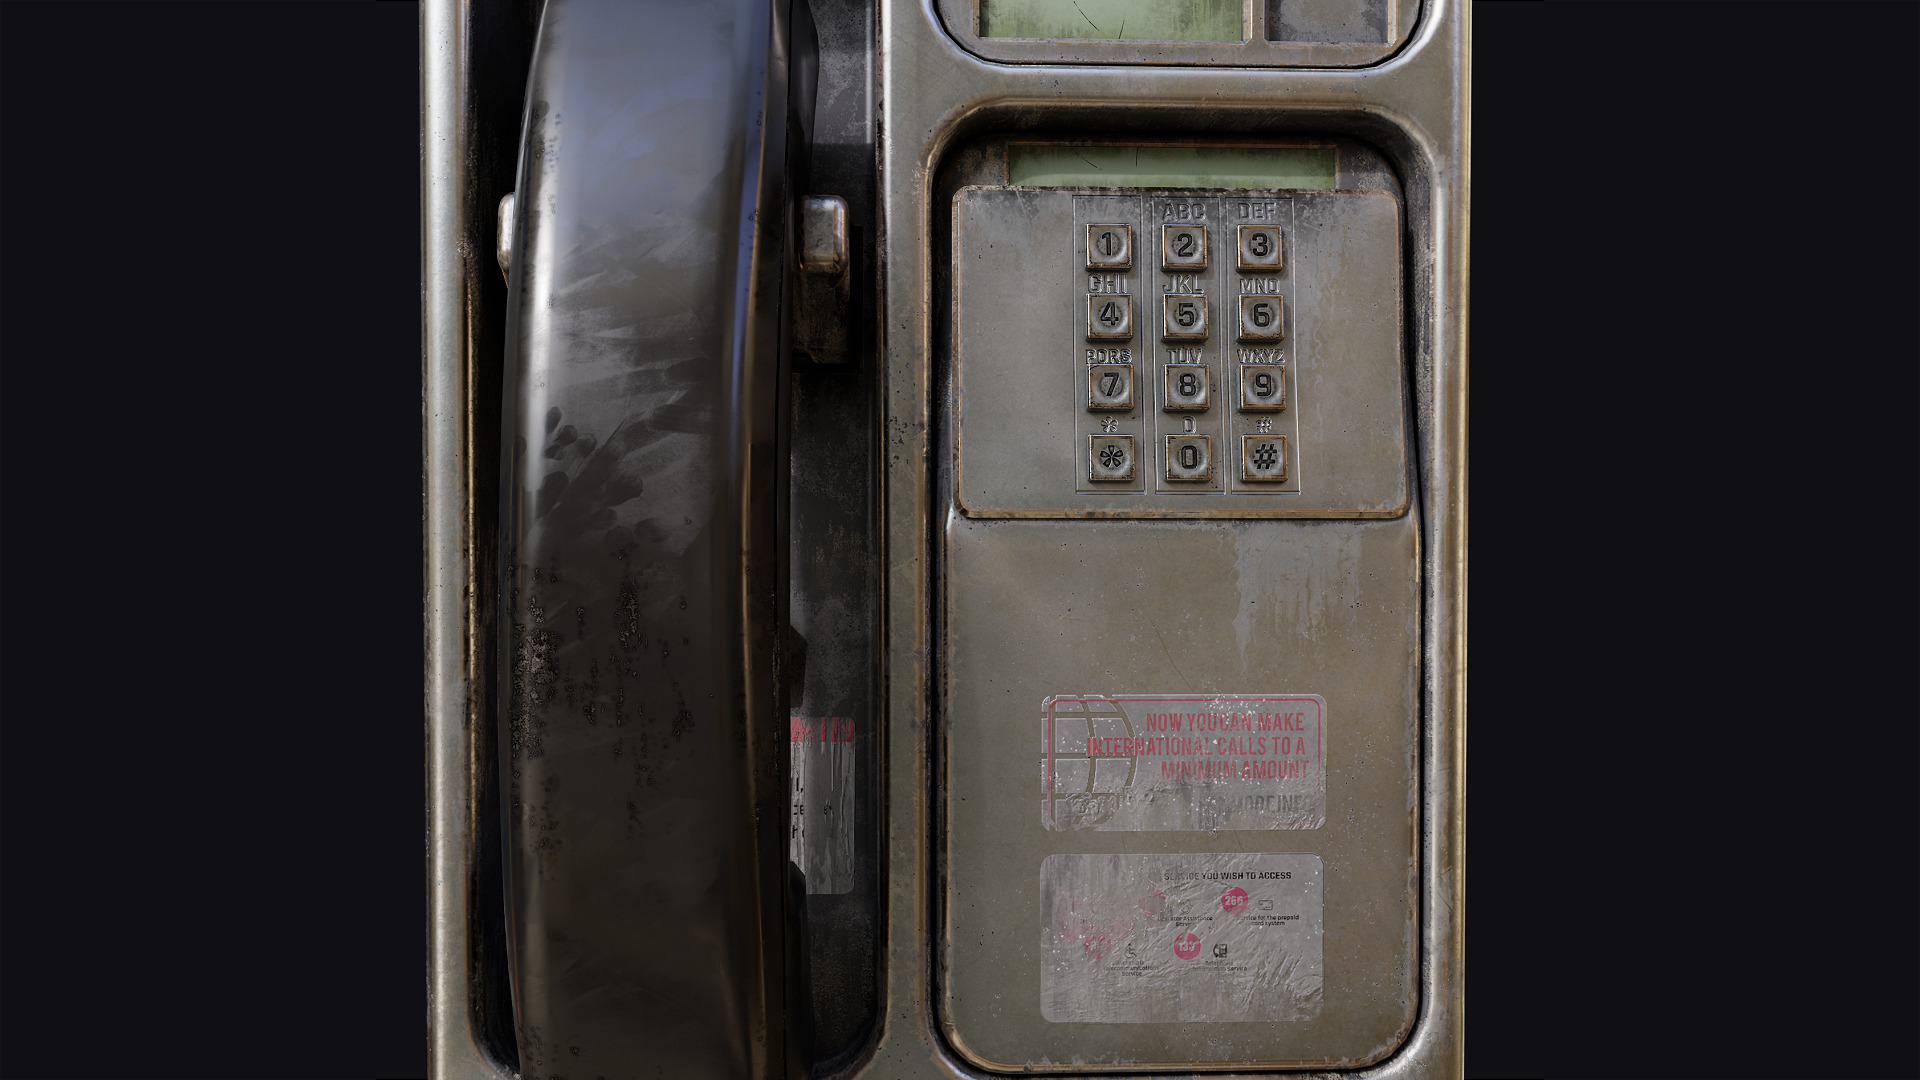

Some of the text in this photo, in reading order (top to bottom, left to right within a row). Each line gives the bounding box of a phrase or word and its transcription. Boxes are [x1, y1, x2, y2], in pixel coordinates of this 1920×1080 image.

[1163, 203, 1206, 221] ABC
[1238, 202, 1277, 221] DEF
[1101, 232, 1111, 256] 1
[1177, 233, 1194, 257] 2
[1252, 233, 1269, 257] 3
[1087, 274, 1128, 293] GHI
[1162, 275, 1204, 293] JKL
[1100, 302, 1119, 326] 4
[1178, 303, 1195, 327] 5
[1253, 303, 1270, 327] 6
[1166, 348, 1203, 364] TUV
[1236, 348, 1286, 364] WXYZ
[1103, 372, 1120, 397] 7
[1179, 372, 1197, 397] 8
[1254, 372, 1272, 397] 9
[1180, 445, 1198, 470] 0
[1146, 713, 1183, 732] NOW
[1257, 713, 1305, 732] MAKE
[1086, 737, 1306, 756] INTERNATIONAL CALLS TO A
[1161, 760, 1310, 780] MINIMUM AMOUNT
[1202, 872, 1219, 880] YOU
[1220, 871, 1244, 880] WISH
[1246, 871, 1256, 880] TO
[1258, 871, 1292, 880] ACCESS
[1224, 896, 1244, 906] 266
